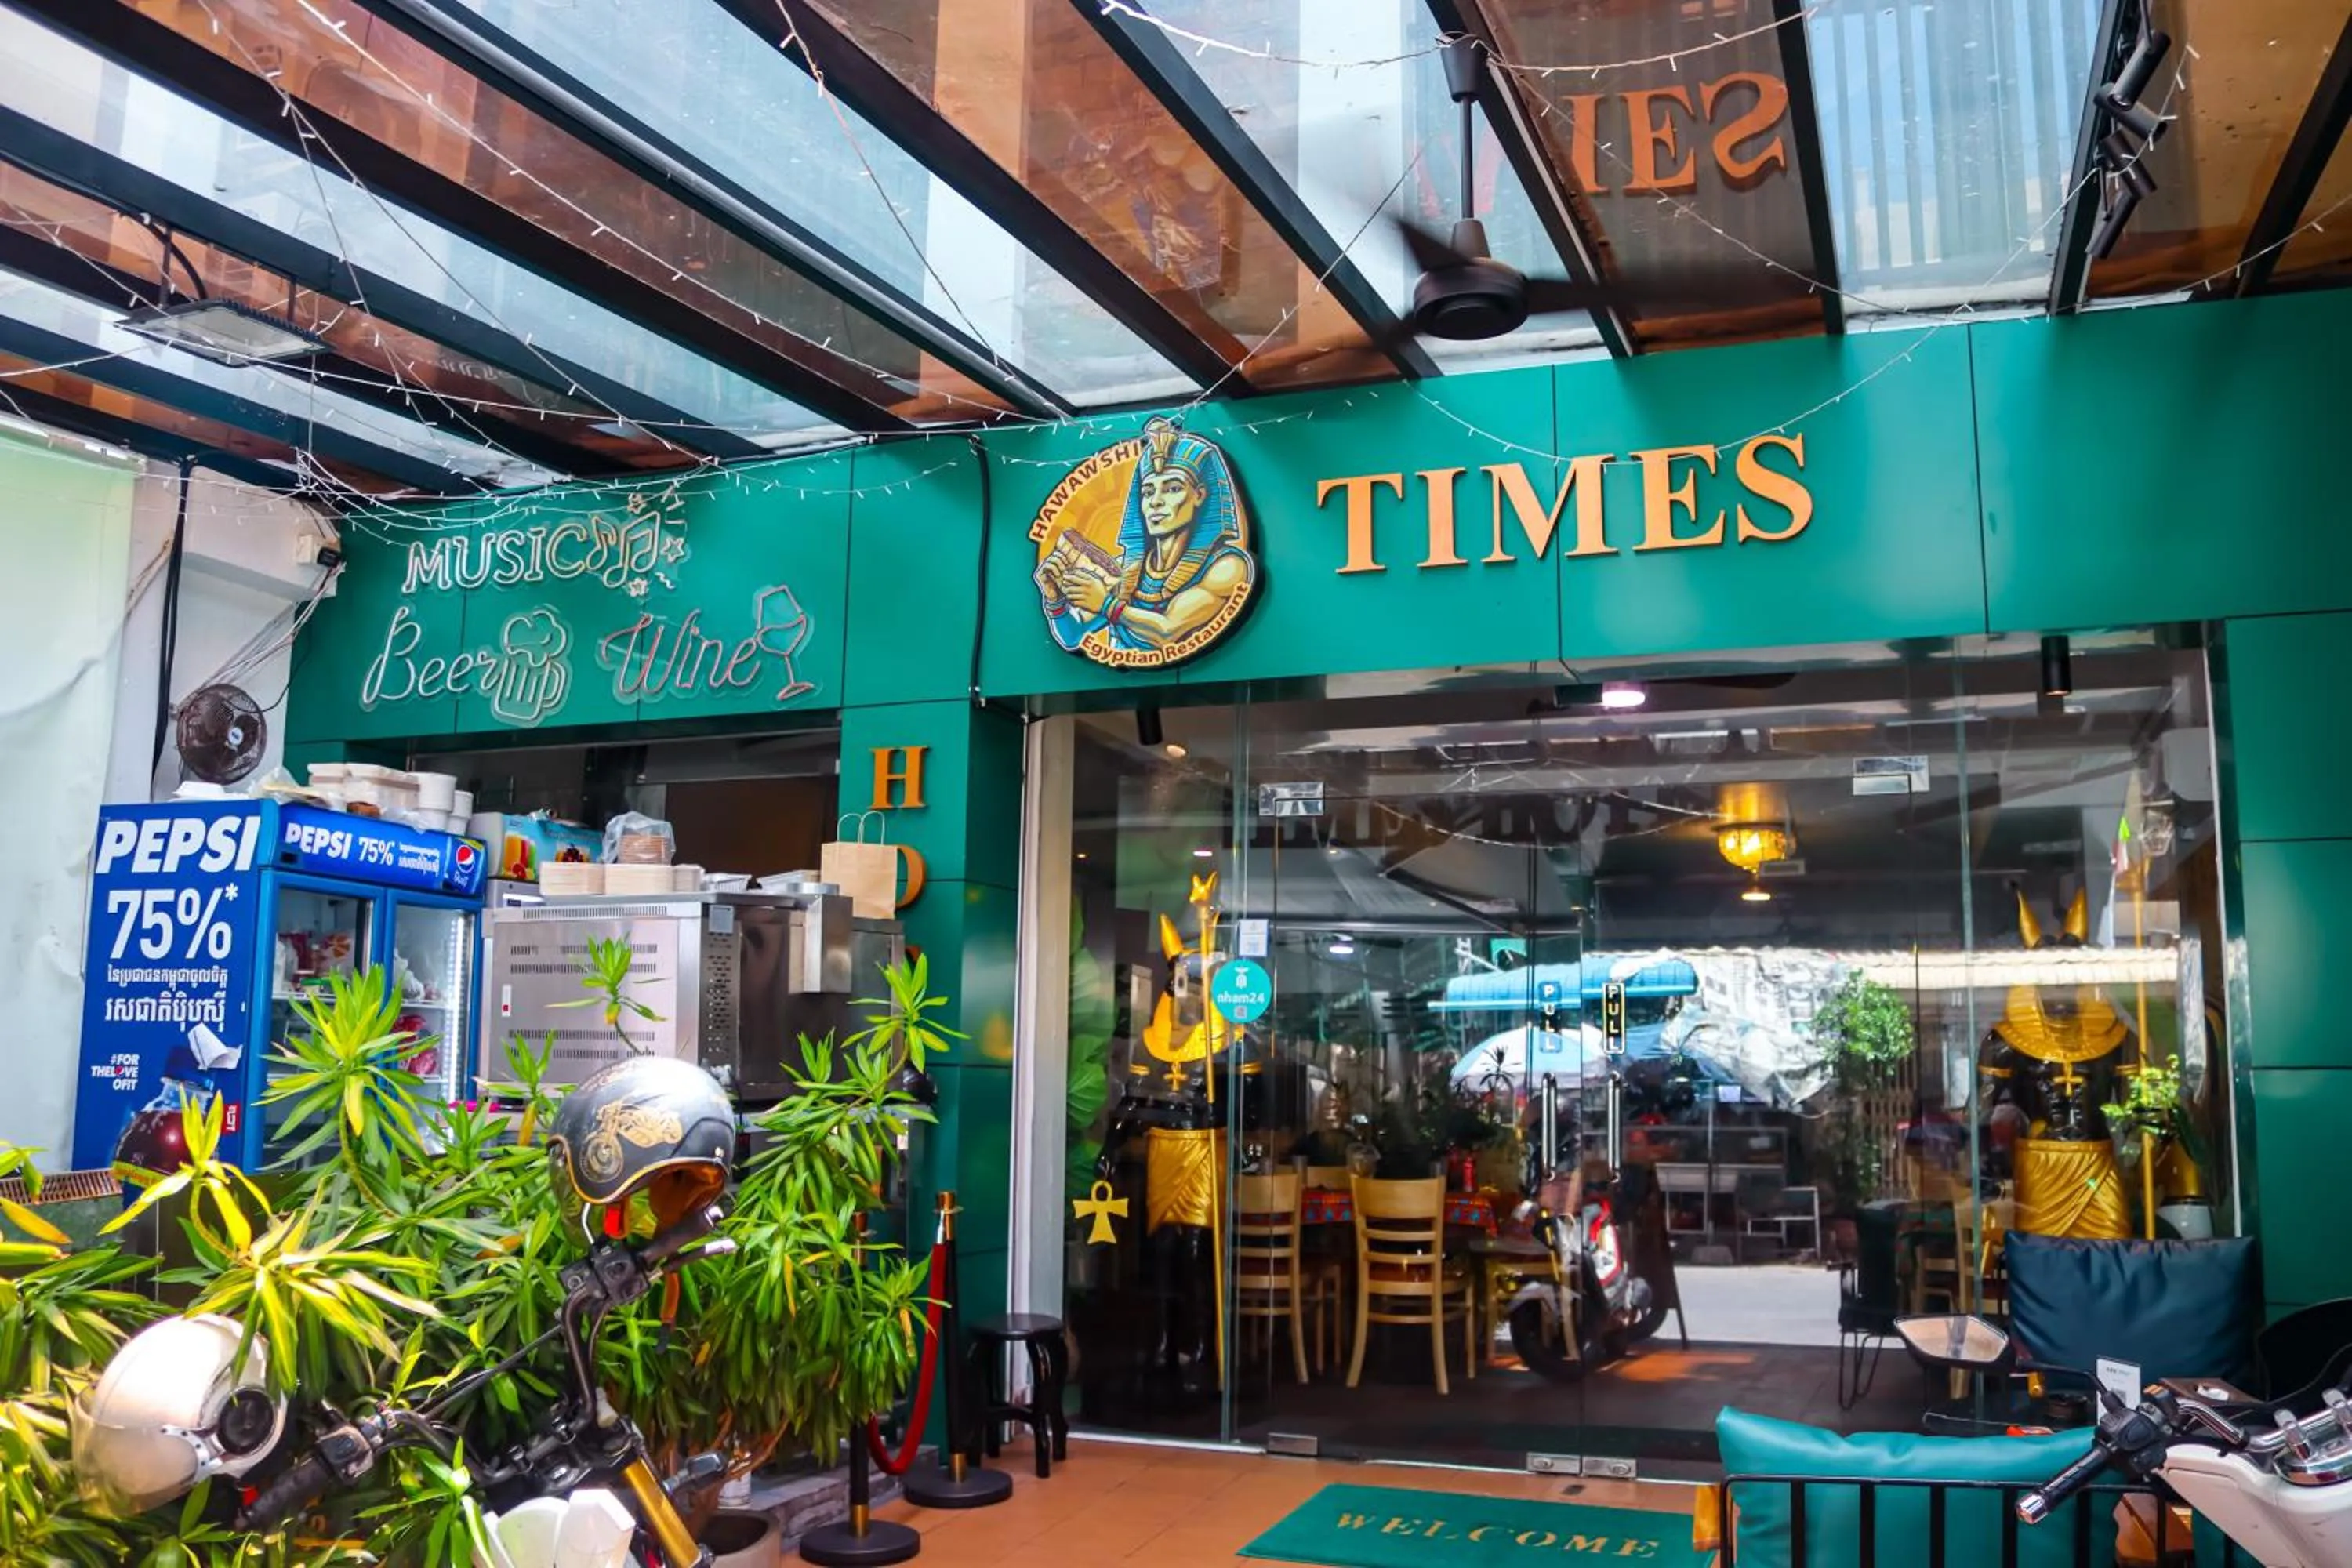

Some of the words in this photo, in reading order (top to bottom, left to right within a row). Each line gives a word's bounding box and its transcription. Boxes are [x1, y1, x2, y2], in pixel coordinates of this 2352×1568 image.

[1030, 441, 1141, 541] HAWAWSHI
[1316, 432, 1813, 574] TIMES
[402, 523, 588, 593] MUSIC
[361, 606, 499, 706] Beer
[601, 608, 761, 695] Wine
[1081, 633, 1160, 665] Egyptian
[1165, 583, 1248, 660] Restaurant
[96, 816, 260, 873] PEPSI
[285, 822, 353, 860] PEPSI
[358, 837, 395, 866] 75%
[1217, 990, 1265, 1004] nham24
[1543, 984, 1555, 1050] PULL
[1607, 985, 1620, 1051] PULL
[111, 1054, 140, 1065] #FOR
[1338, 1512, 1659, 1557] WELCOME
